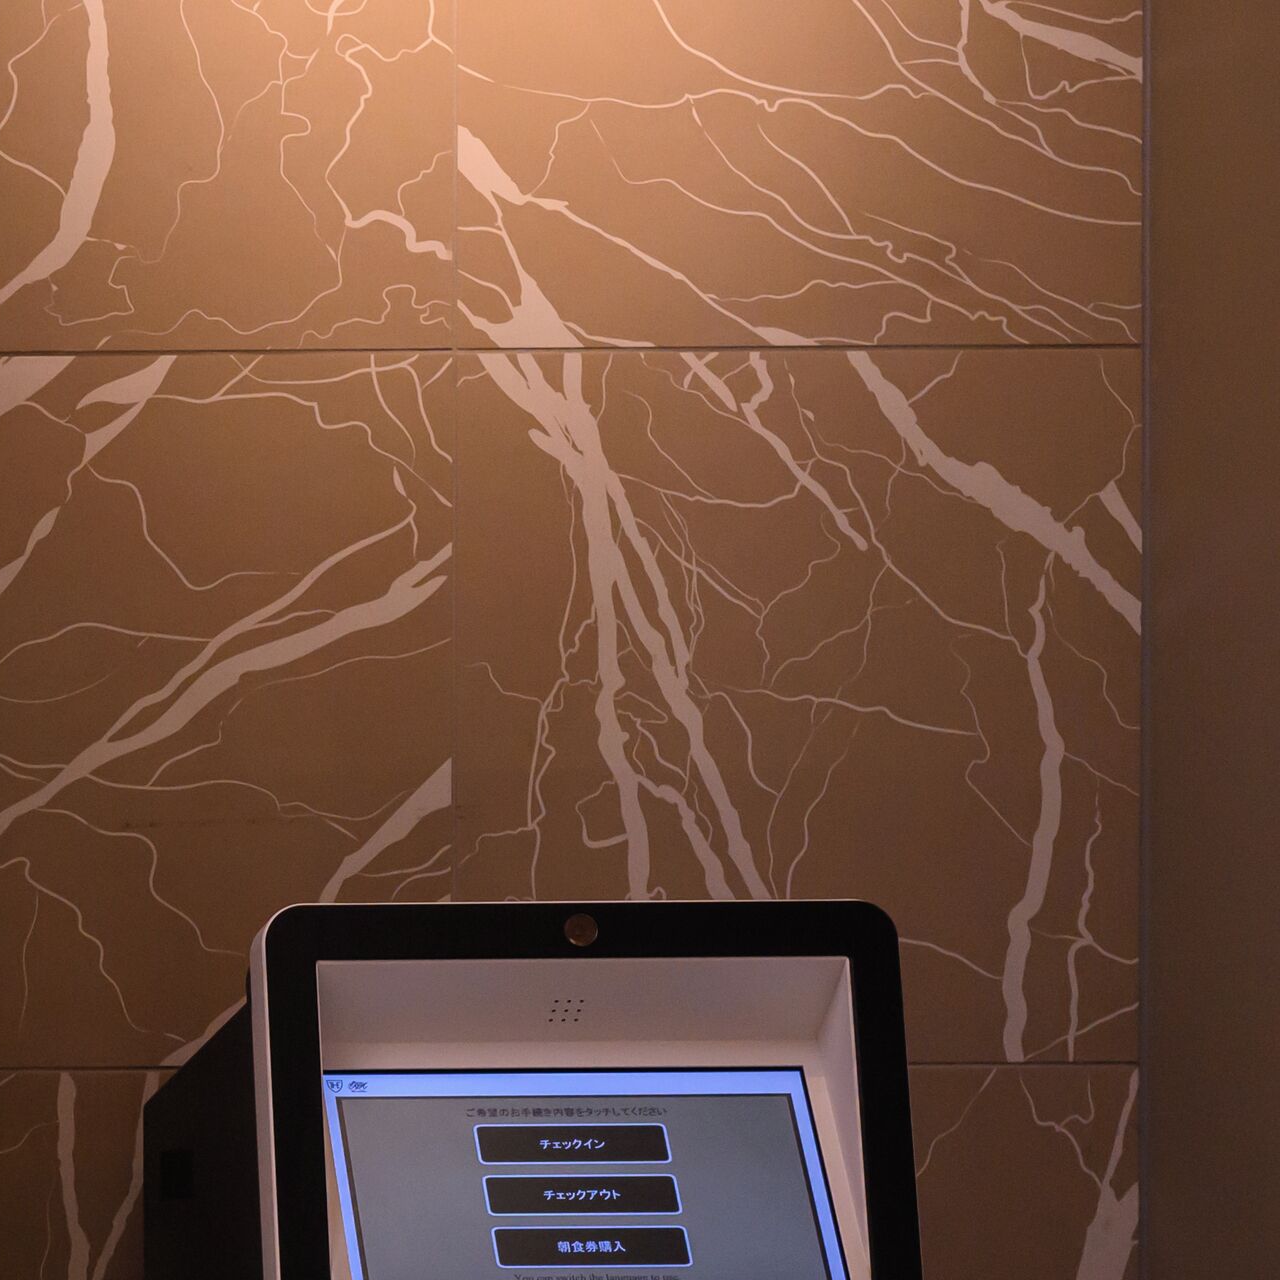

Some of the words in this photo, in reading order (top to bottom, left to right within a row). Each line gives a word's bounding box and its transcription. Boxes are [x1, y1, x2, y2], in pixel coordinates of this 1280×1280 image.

[539, 1138, 606, 1150] チェックイン
[543, 1189, 621, 1201] チェックアウト
[557, 1240, 626, 1253] 朝食券購入
